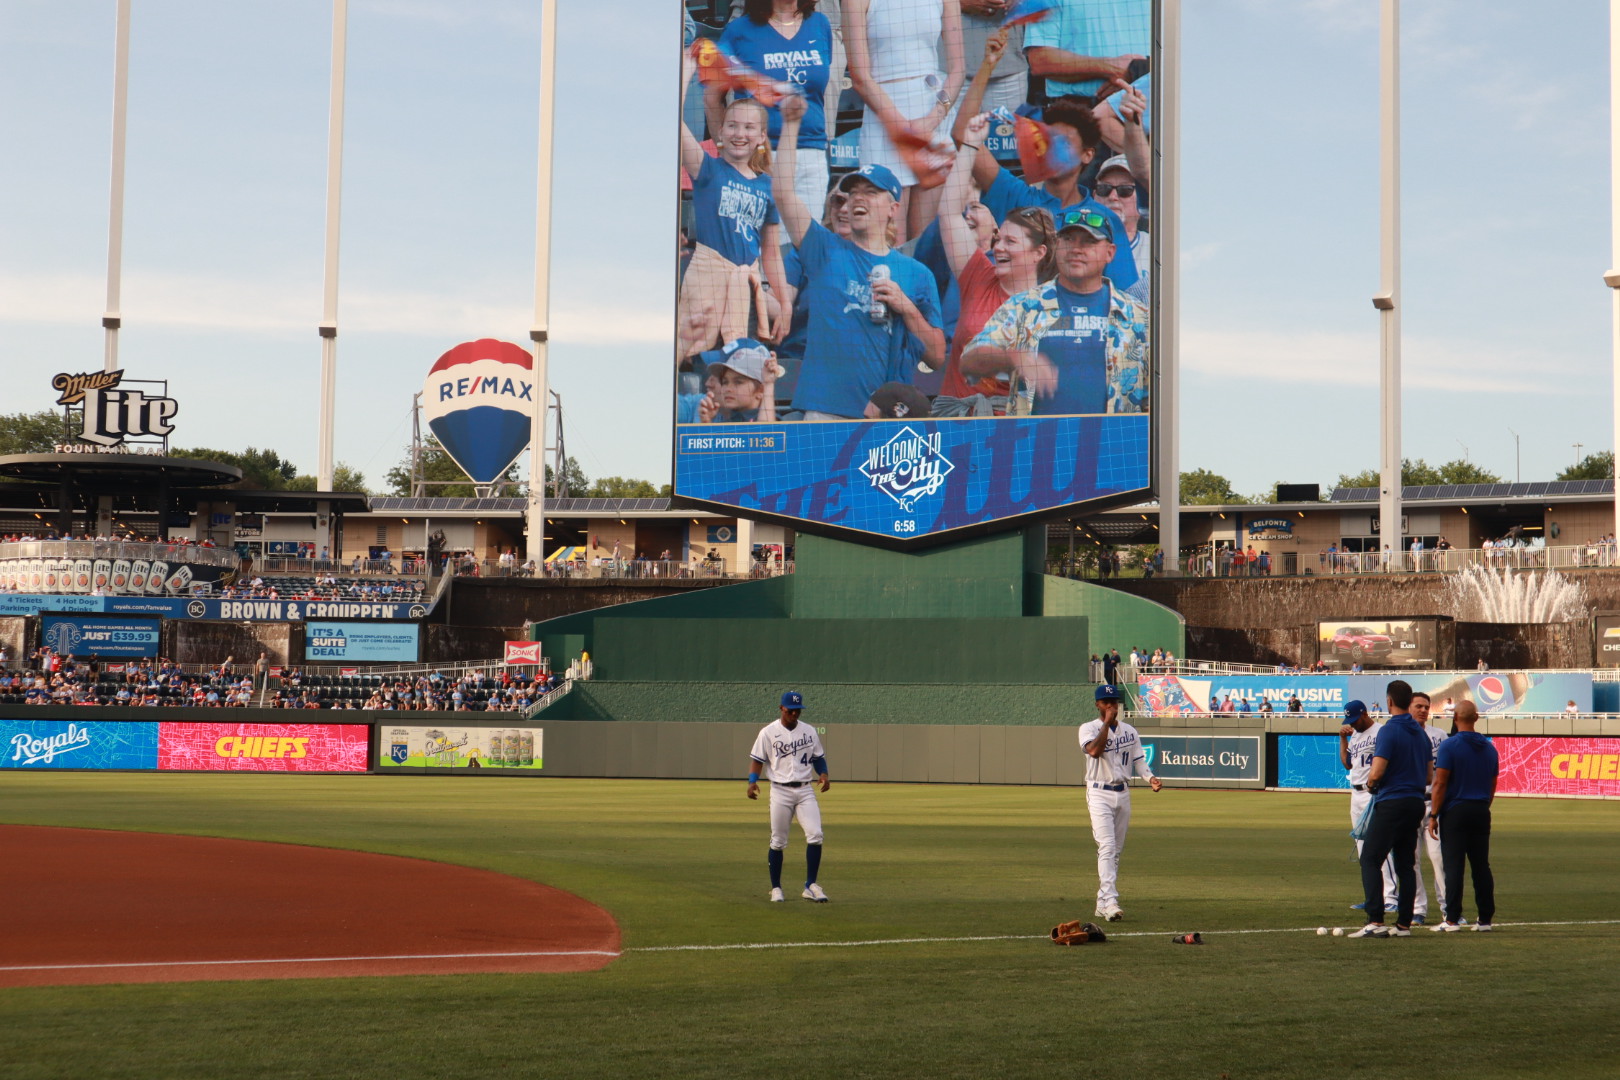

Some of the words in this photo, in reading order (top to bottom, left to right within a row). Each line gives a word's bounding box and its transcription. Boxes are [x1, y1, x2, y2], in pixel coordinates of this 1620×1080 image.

[763, 50, 821, 63] ROYALS
[765, 60, 812, 69] BASEBALL
[786, 68, 807, 85] KC
[53, 373, 119, 402] Miller
[439, 376, 533, 402] RE/MAX
[78, 388, 178, 446] Lite
[688, 438, 714, 449] FIRST
[715, 437, 745, 449] PITCH:
[749, 437, 775, 448] 11:36
[55, 444, 128, 455] FOUNTAIN
[136, 446, 165, 457] BAR
[869, 436, 924, 471] WELCOME
[928, 431, 942, 456] TO
[890, 456, 945, 496] City
[899, 497, 914, 513] KC
[894, 520, 915, 532] 6:58
[1253, 519, 1287, 528] BELFONTE
[94, 563, 110, 574] Lite
[114, 562, 130, 574] Lite
[133, 562, 149, 574] Lite
[152, 562, 168, 575] Lite
[76, 598, 99, 606] Dogs
[191, 604, 203, 613] BC
[0, 604, 32, 614] Parking
[221, 602, 282, 619] BROWN
[287, 603, 300, 619] &
[82, 632, 111, 640] JUST
[114, 632, 152, 641] $39.99
[313, 628, 333, 636] IT'S
[336, 628, 345, 636] A
[312, 638, 345, 647] SUITE
[312, 648, 346, 656] DEAL!
[511, 649, 534, 657] SONIC
[1105, 686, 1114, 694] KC
[792, 695, 800, 703] KC
[10, 723, 90, 765] Royals
[215, 736, 309, 759] CHIEFS
[772, 732, 814, 758] Royals
[1105, 730, 1135, 754] oyals
[392, 746, 407, 760] KC
[1122, 750, 1130, 766] 11
[1161, 750, 1215, 766] Kansas
[1219, 751, 1249, 769] City
[1361, 753, 1374, 767] 14
[1550, 753, 1620, 780] CHIE
